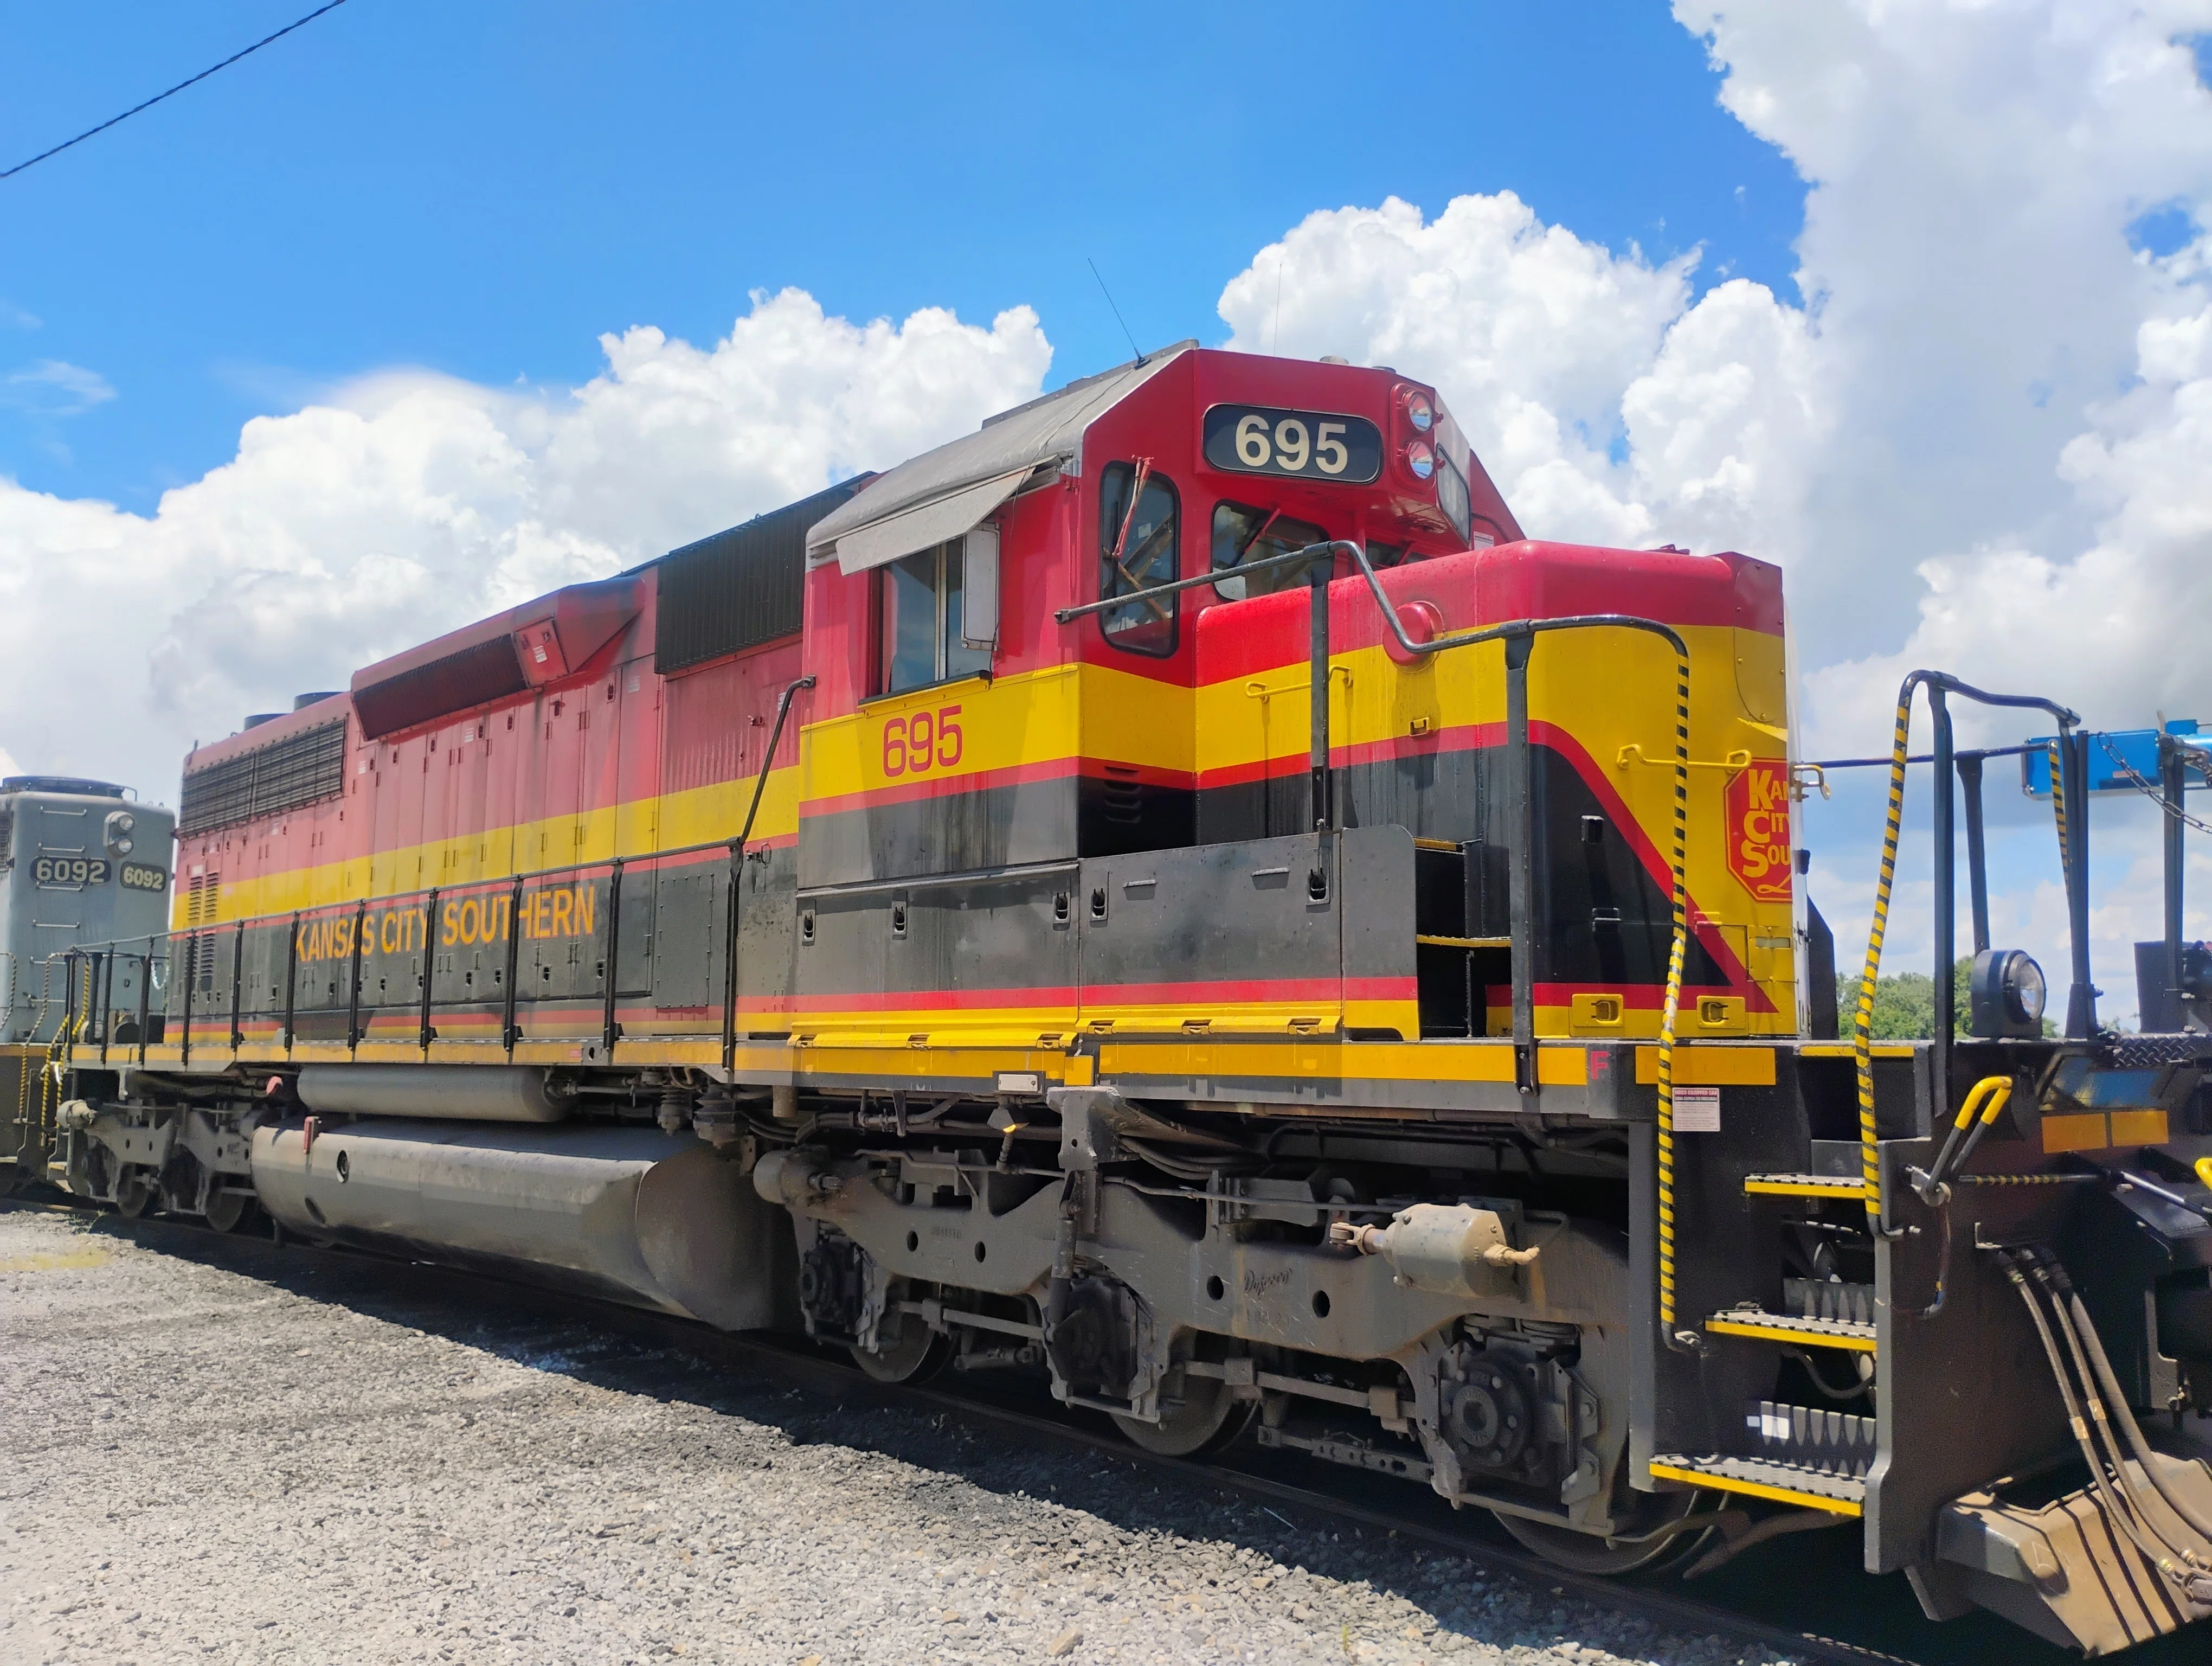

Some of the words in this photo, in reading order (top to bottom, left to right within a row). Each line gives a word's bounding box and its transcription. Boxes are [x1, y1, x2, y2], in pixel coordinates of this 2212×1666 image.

[1236, 414, 1348, 475] 695
[883, 704, 963, 777] 695
[36, 859, 106, 883] 6092
[123, 866, 163, 890] 6092
[381, 907, 428, 954] CITY
[441, 885, 595, 947] SOUTHERN
[1591, 1050, 1609, 1080] F
